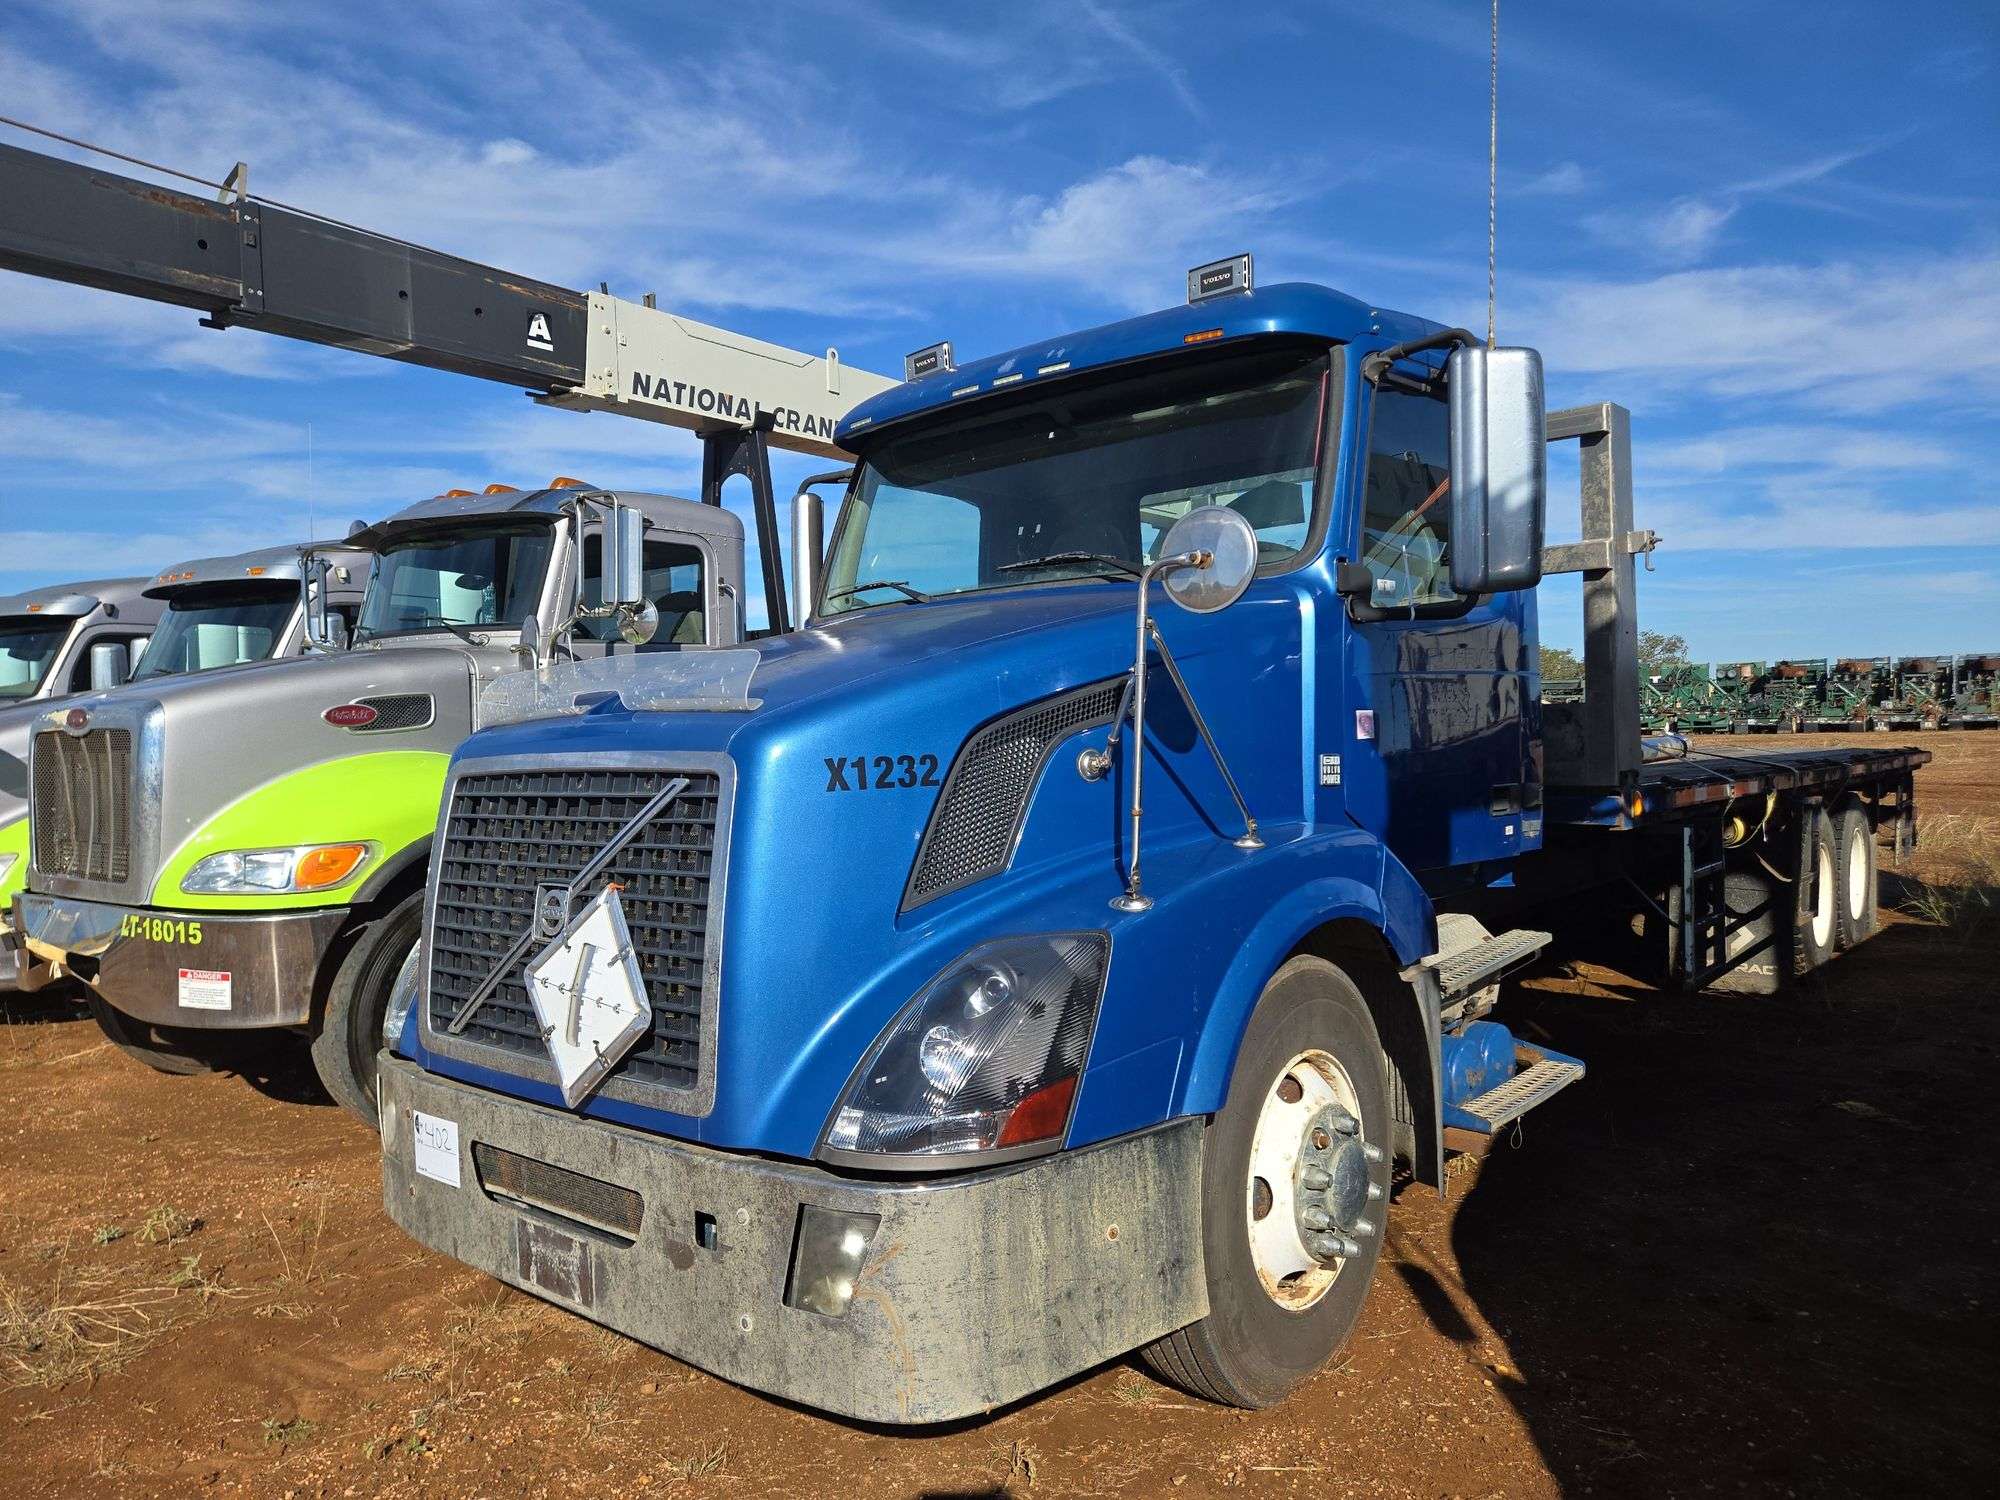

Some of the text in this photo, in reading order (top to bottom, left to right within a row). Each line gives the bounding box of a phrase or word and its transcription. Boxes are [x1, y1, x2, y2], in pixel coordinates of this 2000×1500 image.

[1203, 273, 1231, 285] VOLVO
[823, 753, 941, 792] X1232
[120, 913, 203, 945] LT-18015
